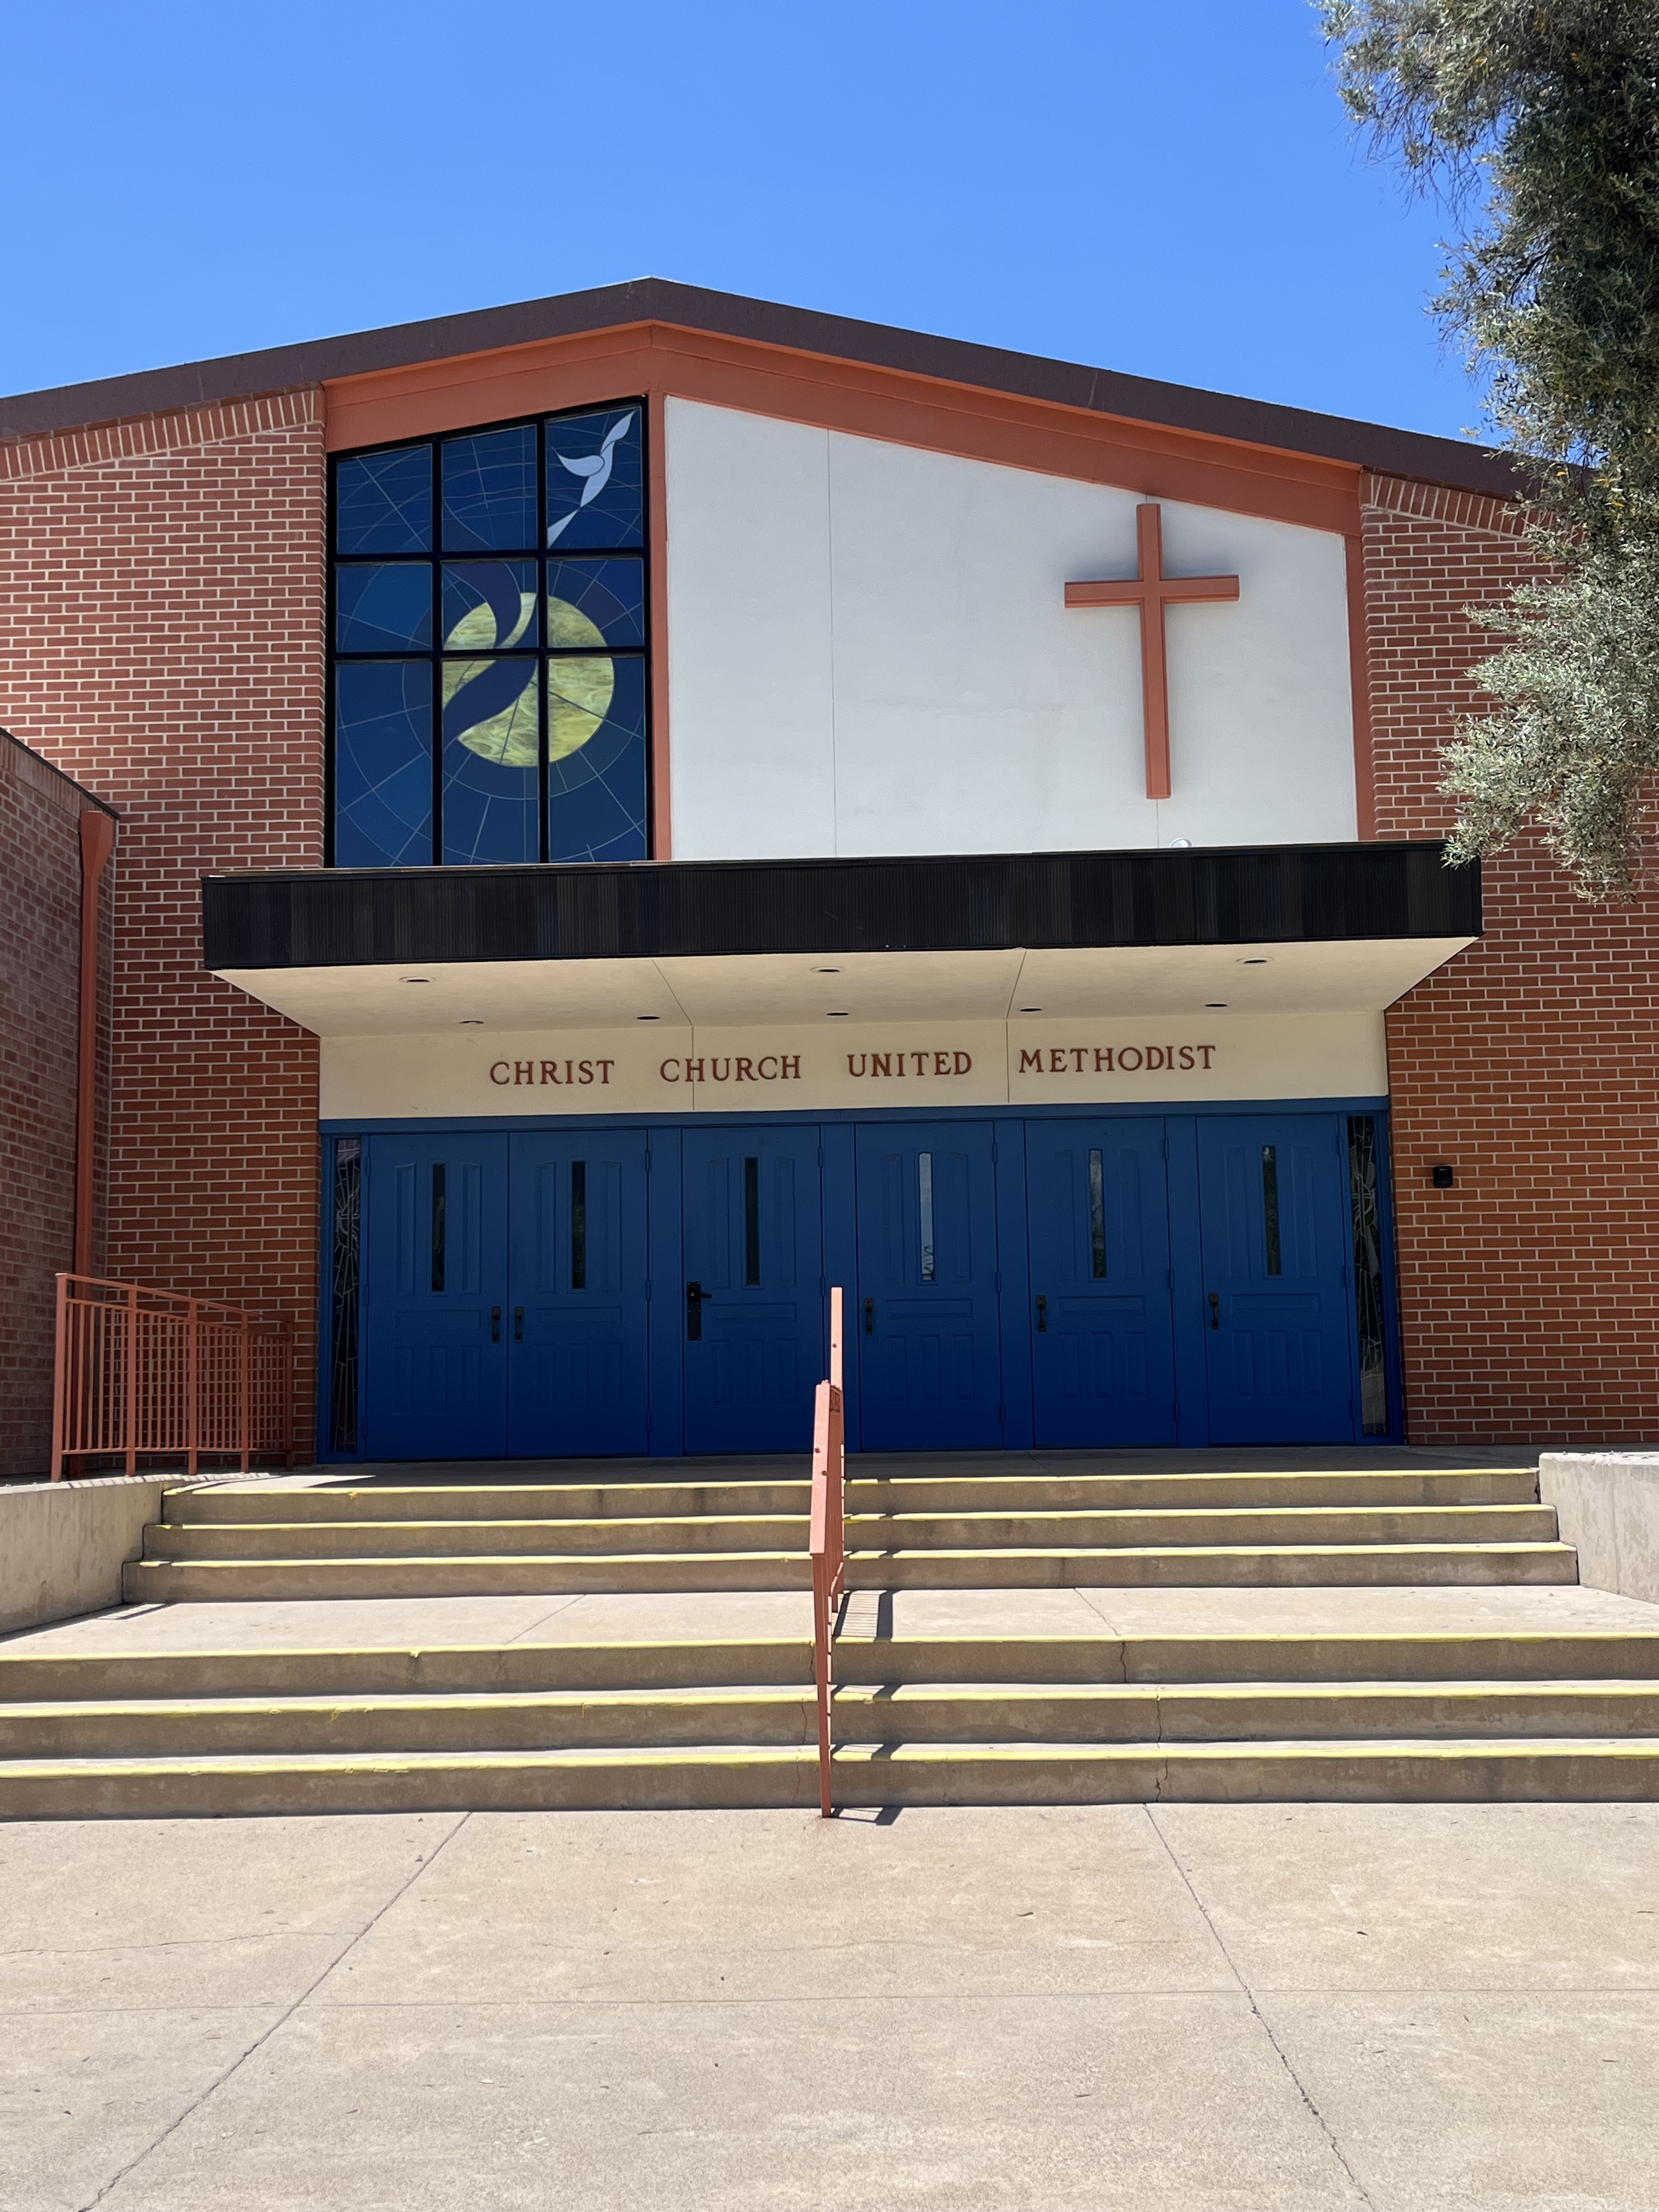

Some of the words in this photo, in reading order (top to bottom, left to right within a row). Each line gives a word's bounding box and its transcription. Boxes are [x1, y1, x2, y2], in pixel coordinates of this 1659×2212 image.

[490, 1060, 614, 1085] CHRIST
[660, 1056, 801, 1082] CHURCH
[847, 1051, 972, 1077] UNITED
[1019, 1045, 1216, 1074] METHODIST
